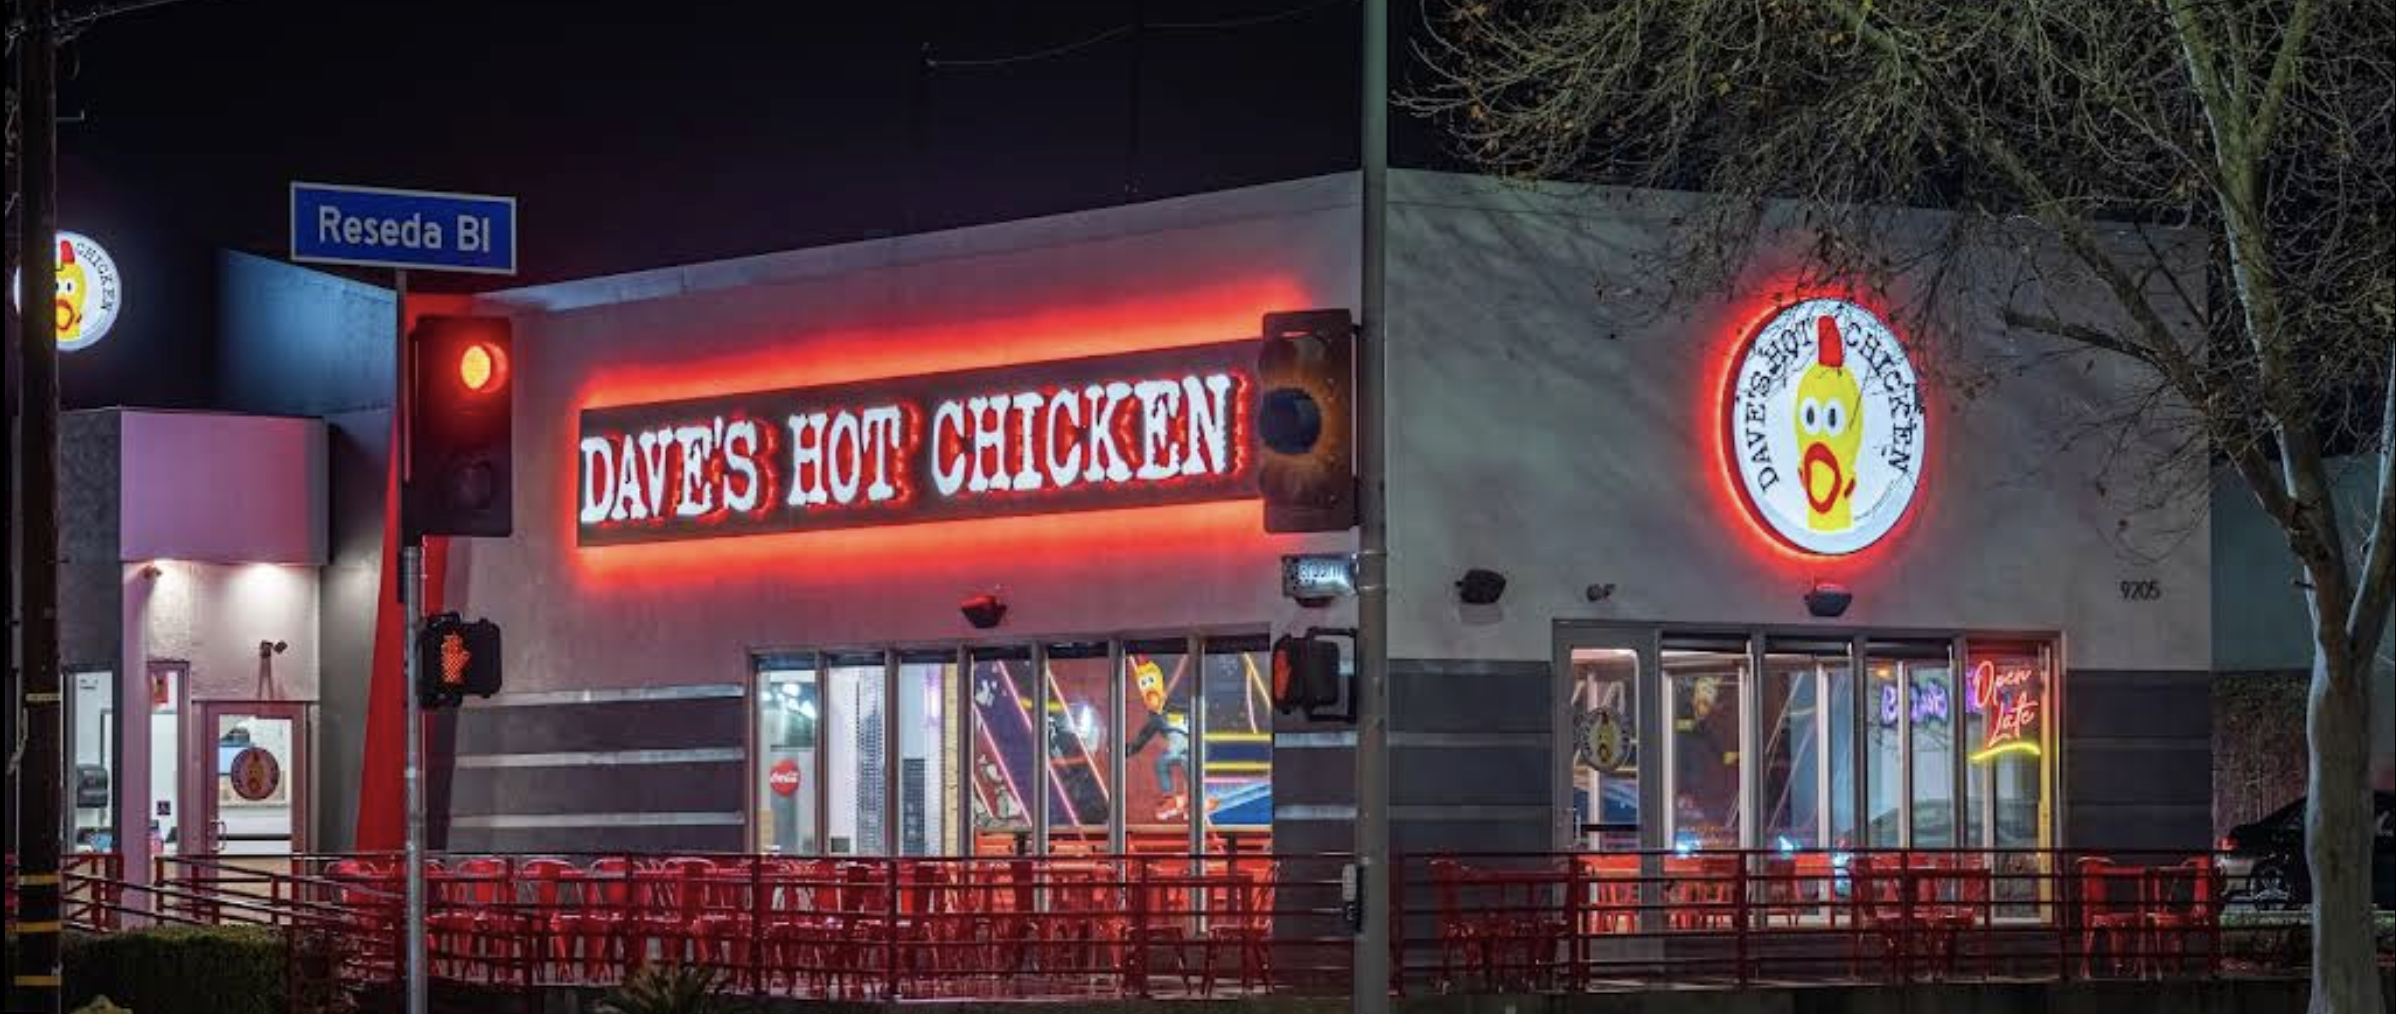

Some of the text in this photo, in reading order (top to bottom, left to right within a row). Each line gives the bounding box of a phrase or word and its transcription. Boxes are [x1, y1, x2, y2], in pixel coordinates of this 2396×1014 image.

[319, 204, 490, 253] Reseda Bl
[78, 243, 115, 311] CHICKEN
[1746, 318, 1914, 491] DAVE'S HOT CHICKEN
[580, 374, 1231, 523] DAVE'S HOT CHICKEN
[2121, 580, 2161, 600] 9205
[1974, 660, 2032, 709] Open
[1988, 690, 2039, 748] Late
